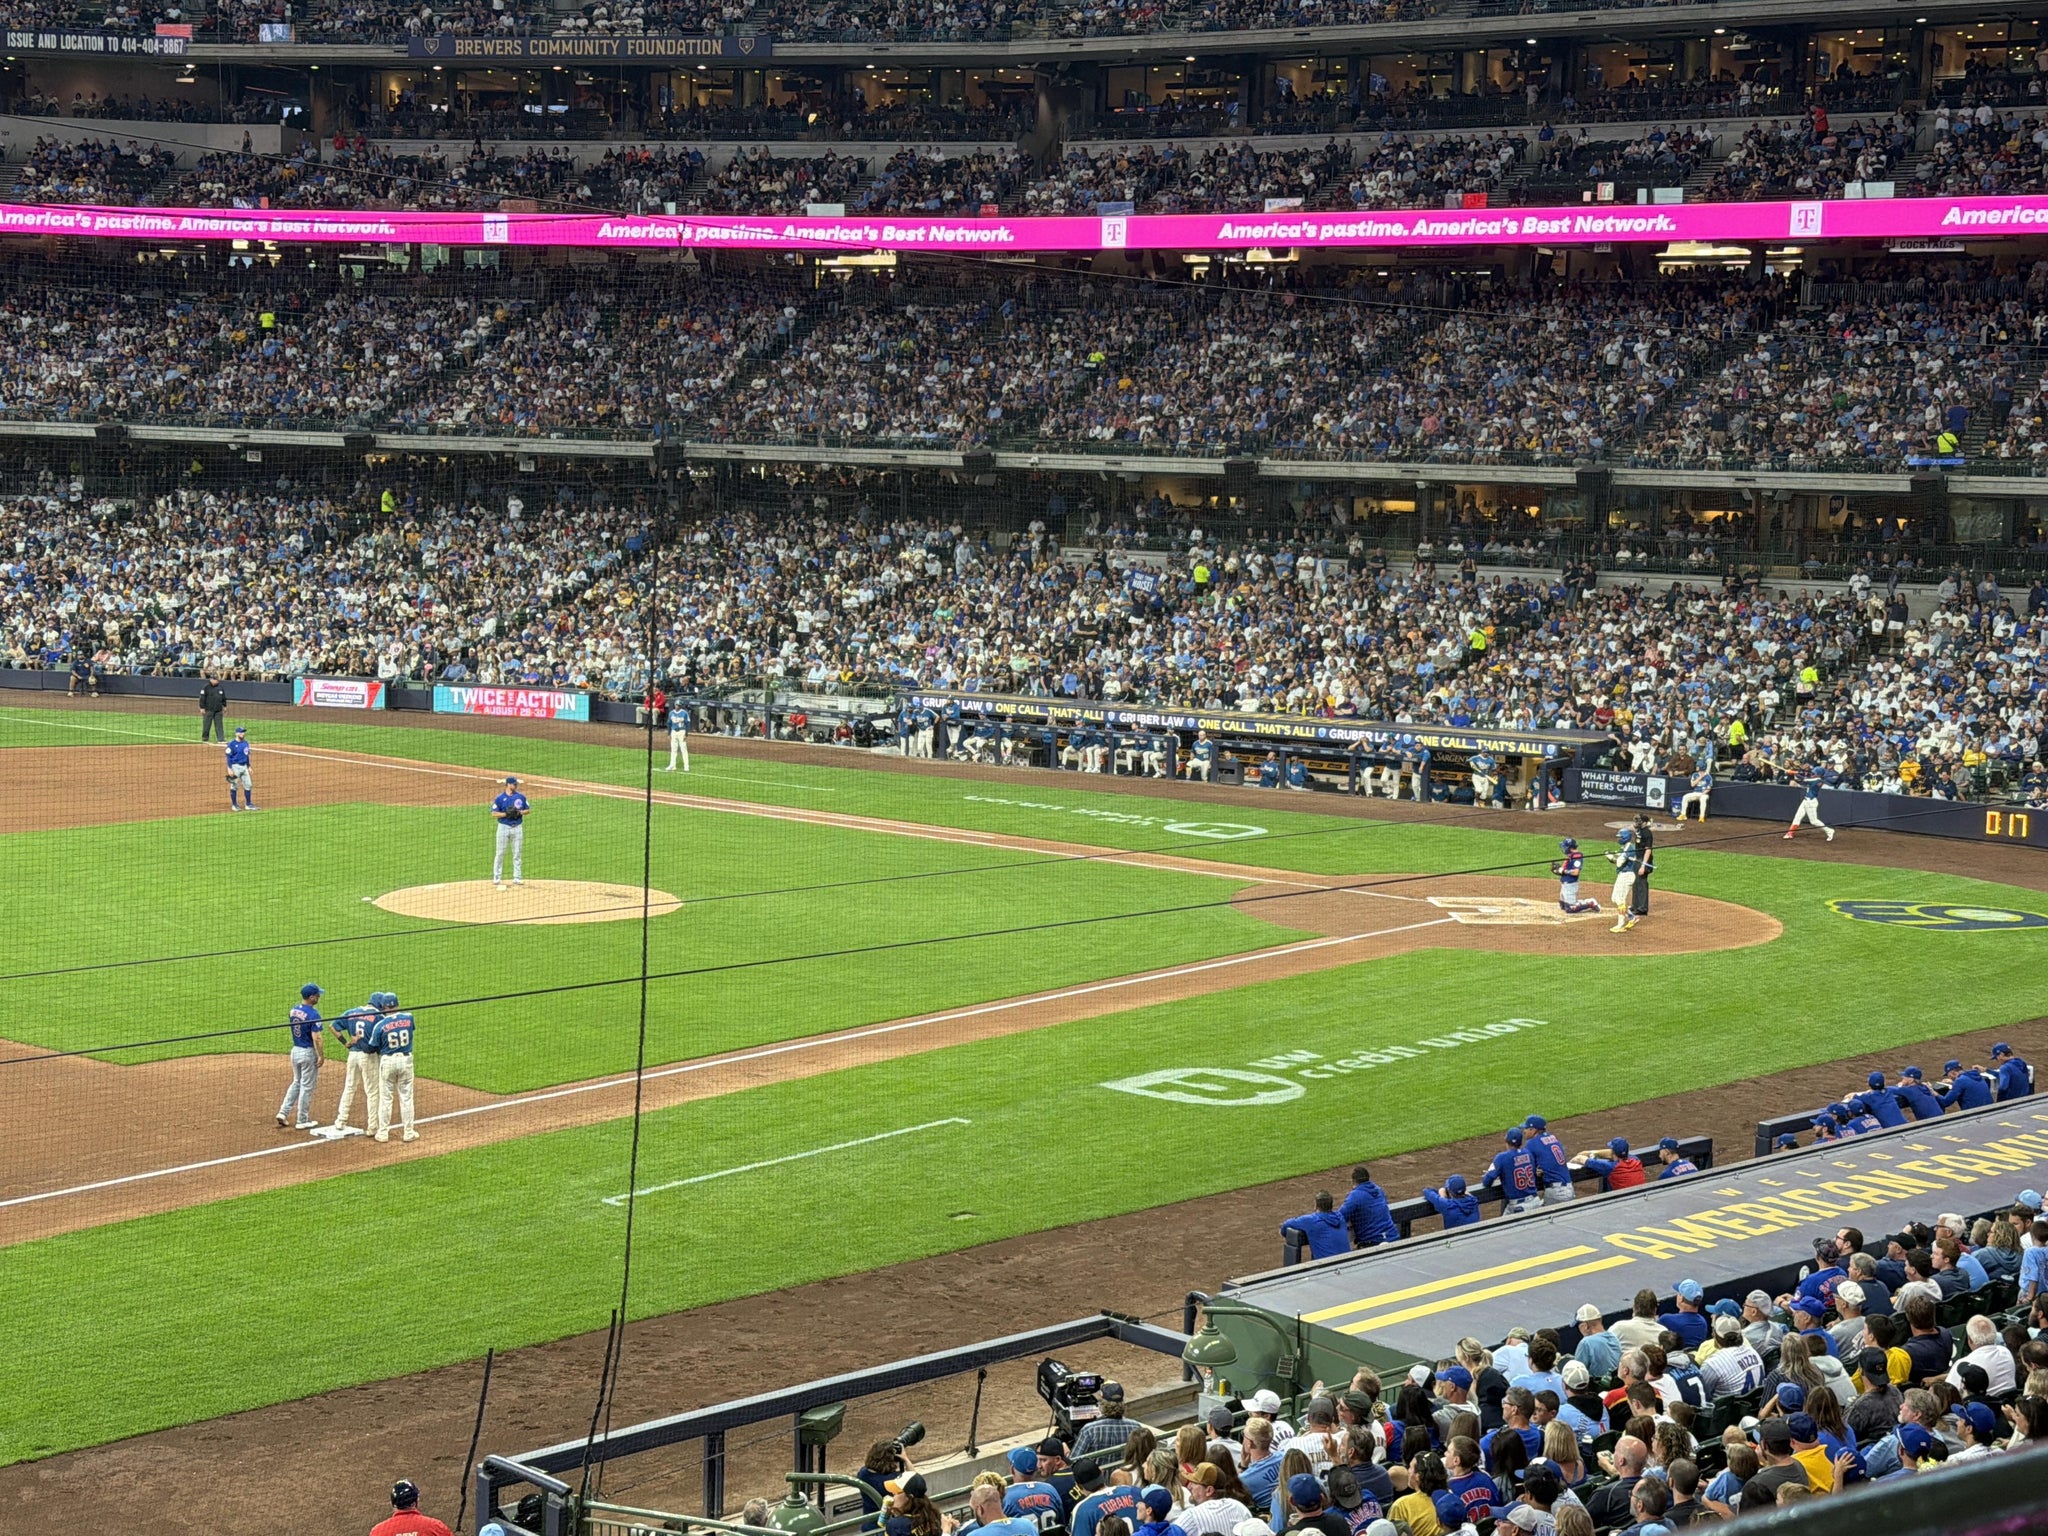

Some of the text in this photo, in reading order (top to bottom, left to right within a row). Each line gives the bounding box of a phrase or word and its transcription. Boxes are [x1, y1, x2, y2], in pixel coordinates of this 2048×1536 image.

[7, 32, 184, 54] ISSUE AND LOCATION TO 414-404-8867
[454, 38, 723, 56] BREWERS COMMUNITY FOUNDATION
[0, 210, 91, 228] merica's
[178, 217, 268, 232] America's
[271, 218, 311, 233] Best
[313, 218, 396, 235] Network.
[1217, 213, 1677, 240] America's pastime. America's Best Network.
[781, 224, 878, 242] America's
[881, 225, 926, 242] Best
[928, 225, 1015, 243] Network.
[1900, 240, 1956, 249] COCKTAILS
[450, 686, 507, 706] TWICE
[515, 690, 576, 711] ACTION
[483, 705, 517, 716] AUGUST
[961, 701, 983, 711] LAW
[995, 702, 1016, 714] ONE
[1083, 709, 1105, 721] ALL!
[1119, 712, 1160, 726] GRUBER
[1161, 716, 1184, 727] LAW
[1198, 718, 1221, 731] ONE
[1293, 725, 1316, 738] ALL!
[1328, 728, 1373, 742] GRUBER
[1415, 735, 1440, 748] ONE
[1519, 741, 1543, 754] ALL!
[1433, 751, 1470, 763] SARGENT
[1581, 771, 1637, 785] WHAT HEAVY
[1581, 780, 1645, 795] HITTERS CARRY.
[355, 1020, 365, 1039] 6
[387, 1029, 409, 1049] 68
[1298, 1017, 1550, 1079] credit union
[1551, 1144, 1566, 1165] 0
[1711, 1135, 1970, 1197] WELCOME
[1513, 1164, 1536, 1190] 65
[1603, 1169, 1950, 1260] AMERICAN
[1738, 1354, 1759, 1371] RIZZO
[1686, 1376, 1707, 1408] 7
[1018, 1493, 1052, 1510] PATRICK
[1098, 1495, 1135, 1515] TURANG
